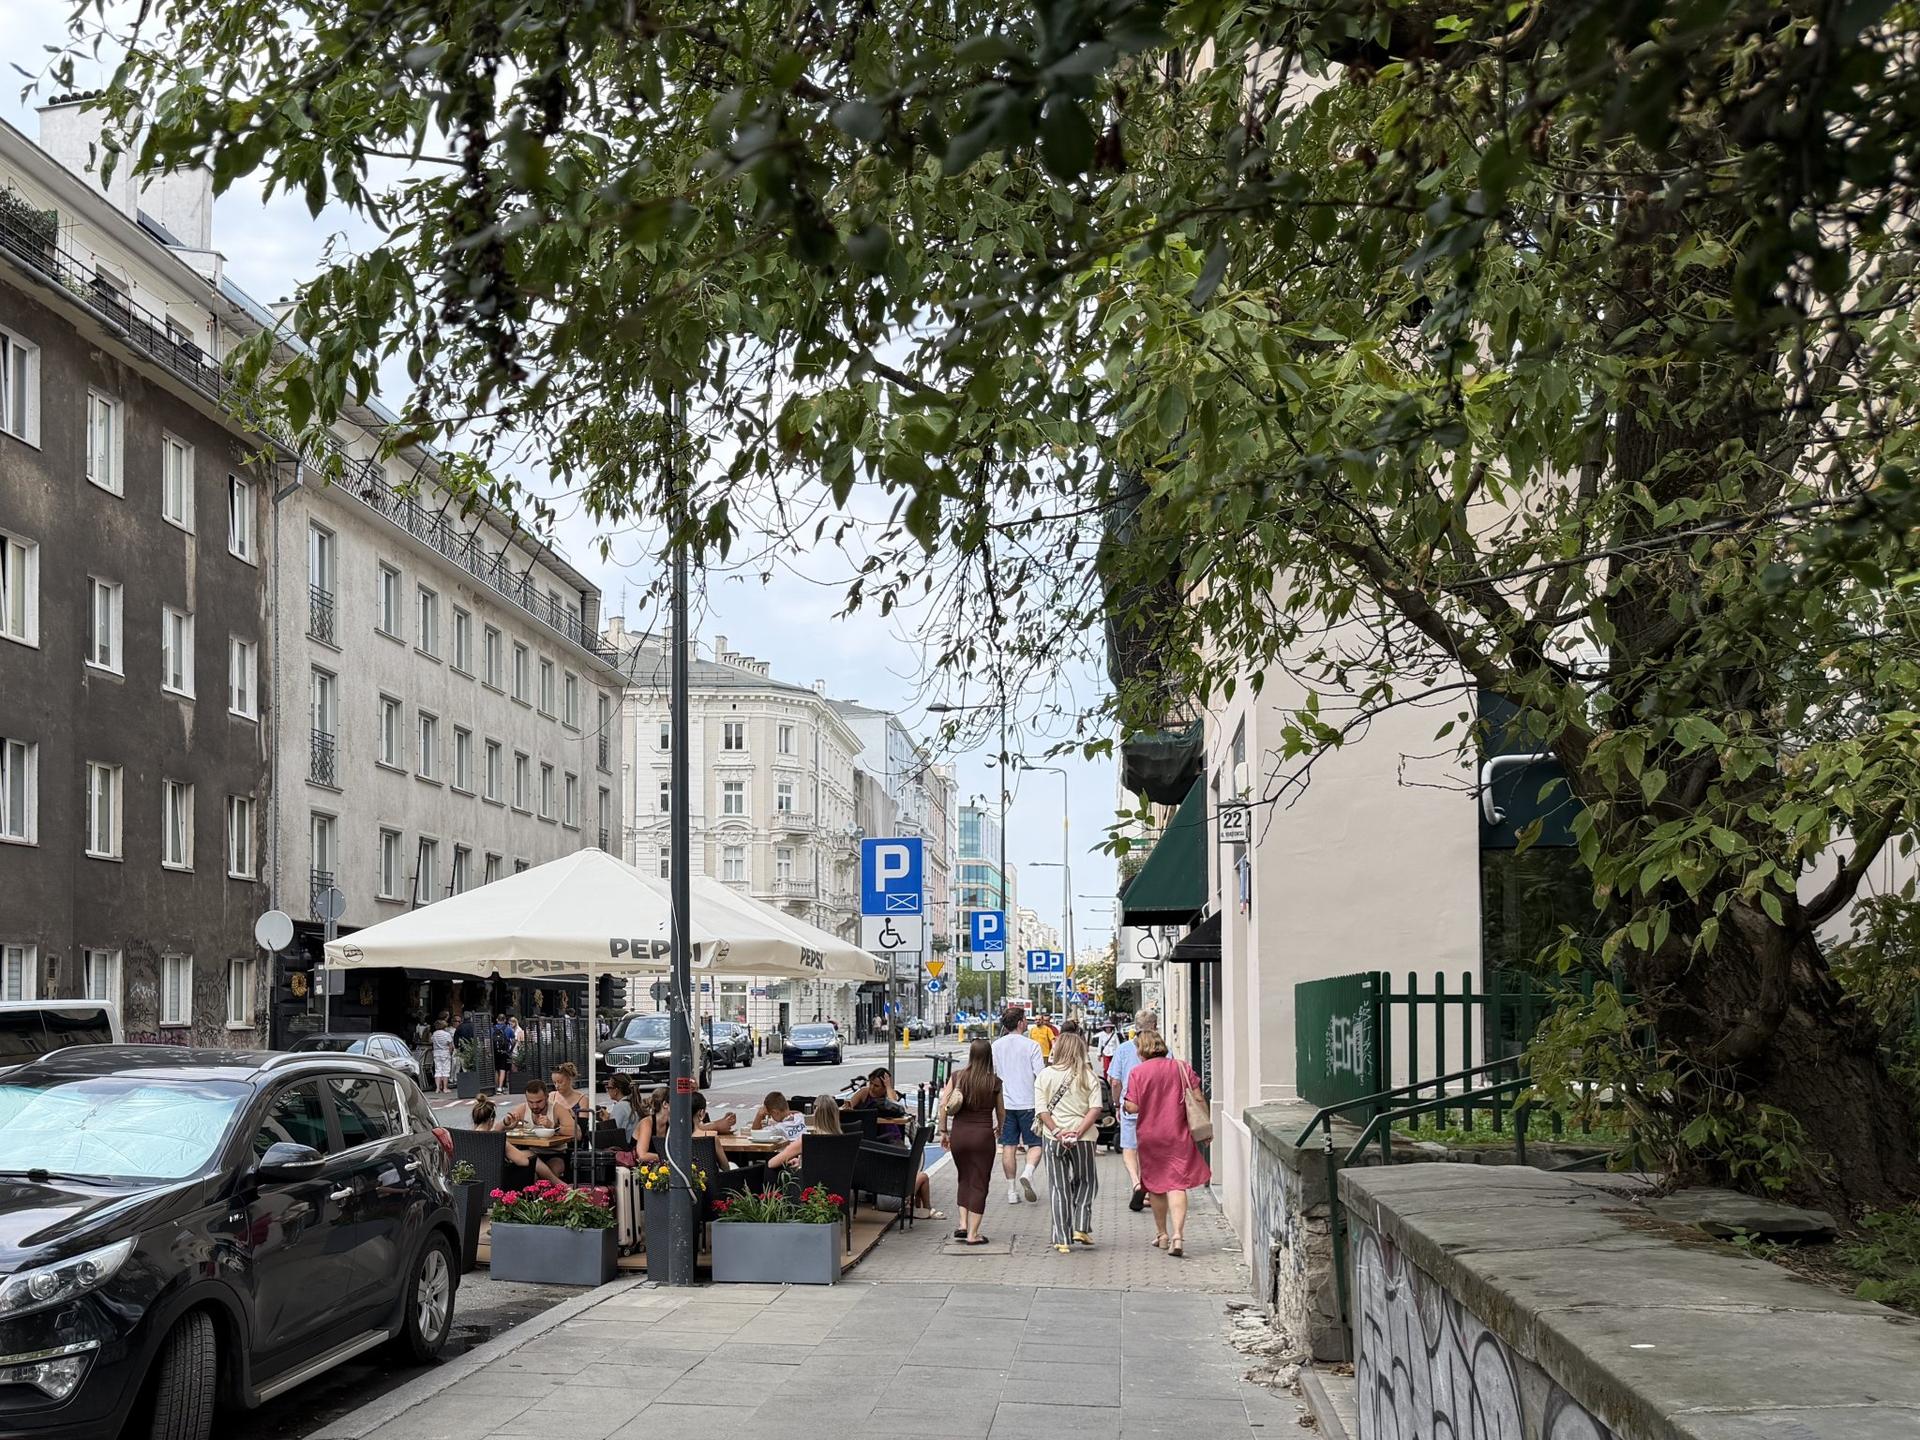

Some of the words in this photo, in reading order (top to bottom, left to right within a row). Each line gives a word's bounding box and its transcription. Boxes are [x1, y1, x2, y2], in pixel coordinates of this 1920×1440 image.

[1223, 812, 1242, 829] 22
[875, 844, 910, 893] P
[978, 914, 998, 940] P
[609, 937, 702, 962] PEPI
[799, 946, 825, 970] PEPSI
[1032, 952, 1046, 971] P
[1049, 954, 1060, 971] P
